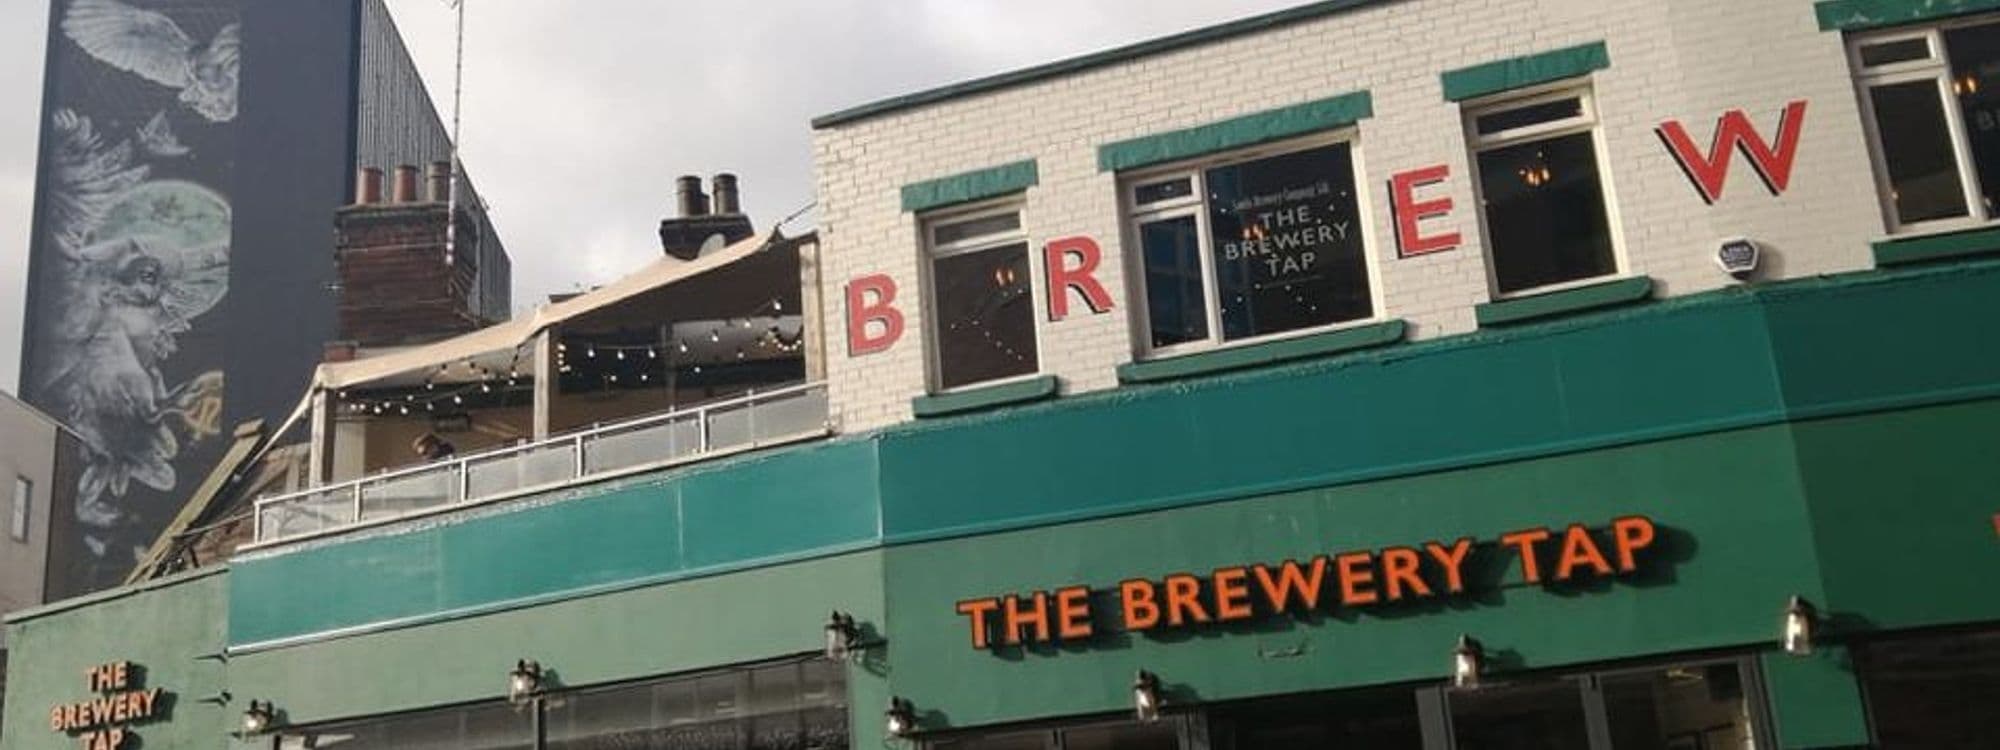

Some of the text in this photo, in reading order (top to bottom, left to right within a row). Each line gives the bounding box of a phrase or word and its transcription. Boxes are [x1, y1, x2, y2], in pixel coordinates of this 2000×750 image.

[1258, 205, 1313, 230] THE
[1224, 220, 1349, 260] BREWERY
[1266, 252, 1316, 277] TAP
[957, 515, 1656, 650] THE BREWERY TAP
[84, 660, 130, 692] THE
[50, 688, 162, 731] BREWERY
[78, 728, 127, 750] TAP
